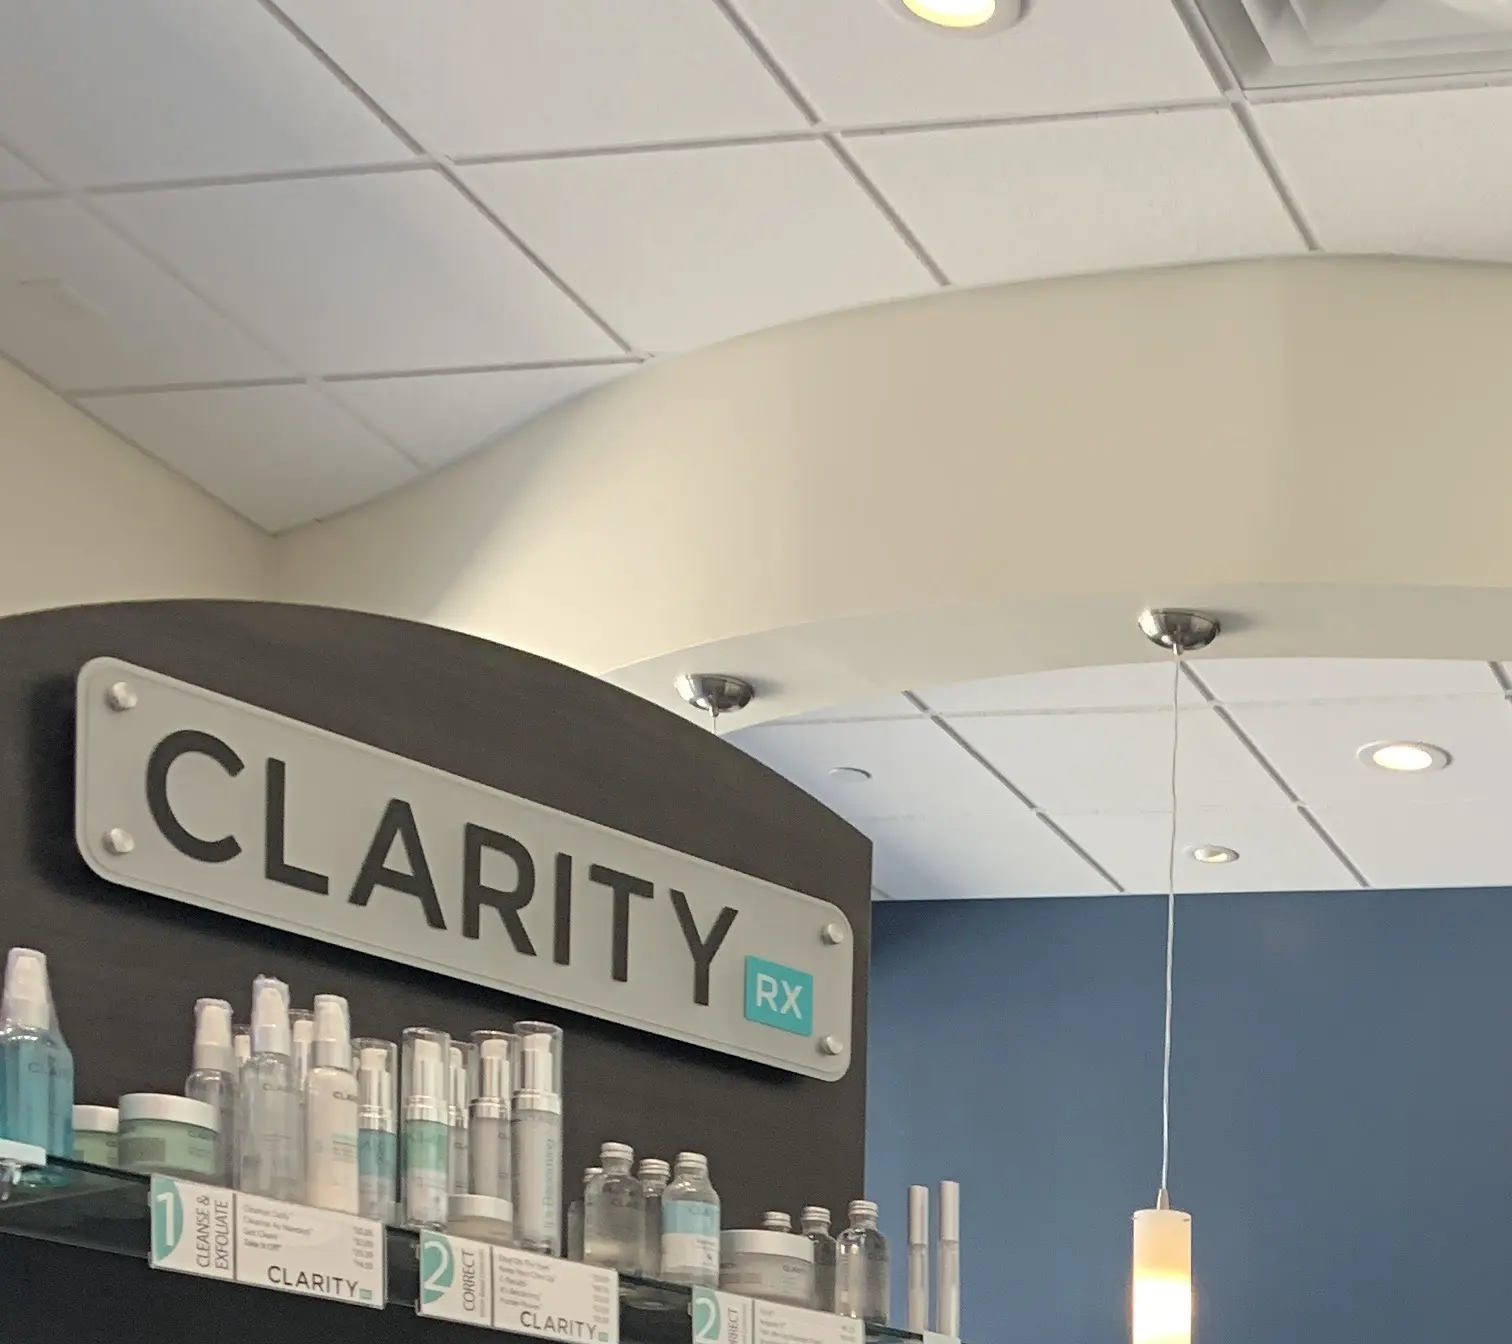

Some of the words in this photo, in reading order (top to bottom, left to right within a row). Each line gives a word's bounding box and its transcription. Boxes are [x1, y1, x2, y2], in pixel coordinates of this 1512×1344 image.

[146, 730, 739, 1006] CLARITY
[754, 972, 804, 1020] RX
[155, 1191, 175, 1248] 1
[196, 1195, 211, 1206] &
[196, 1208, 211, 1268] CLEANSE
[214, 1200, 229, 1271] EXFOLIATE
[267, 1265, 359, 1297] CLARITY
[424, 1240, 453, 1292] 2
[461, 1250, 476, 1311] CORRECT
[519, 1310, 597, 1340] CLARITY
[695, 1297, 720, 1344] 2
